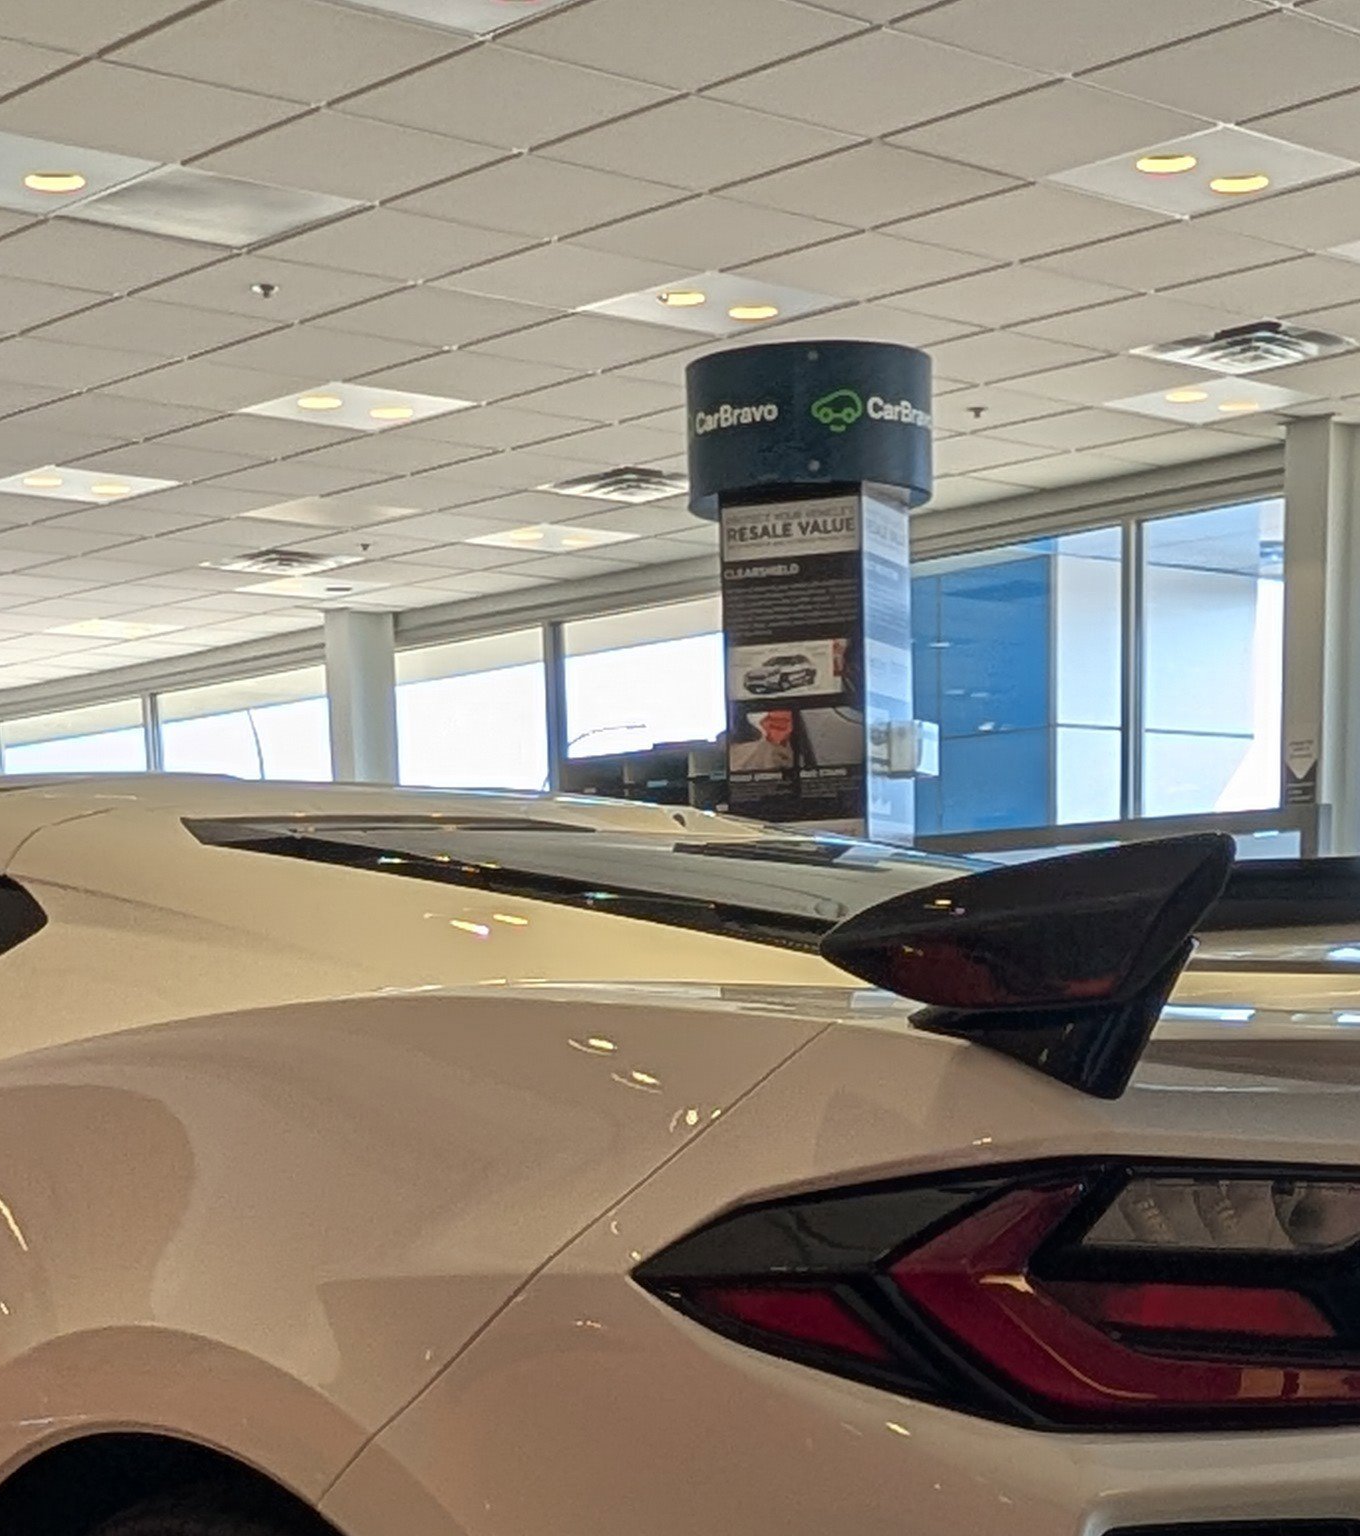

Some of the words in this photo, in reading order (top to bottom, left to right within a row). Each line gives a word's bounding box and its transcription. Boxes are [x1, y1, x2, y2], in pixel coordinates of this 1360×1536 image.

[696, 404, 778, 435] CarBravo
[726, 523, 794, 542] RESALE
[797, 517, 856, 536] VALUE
